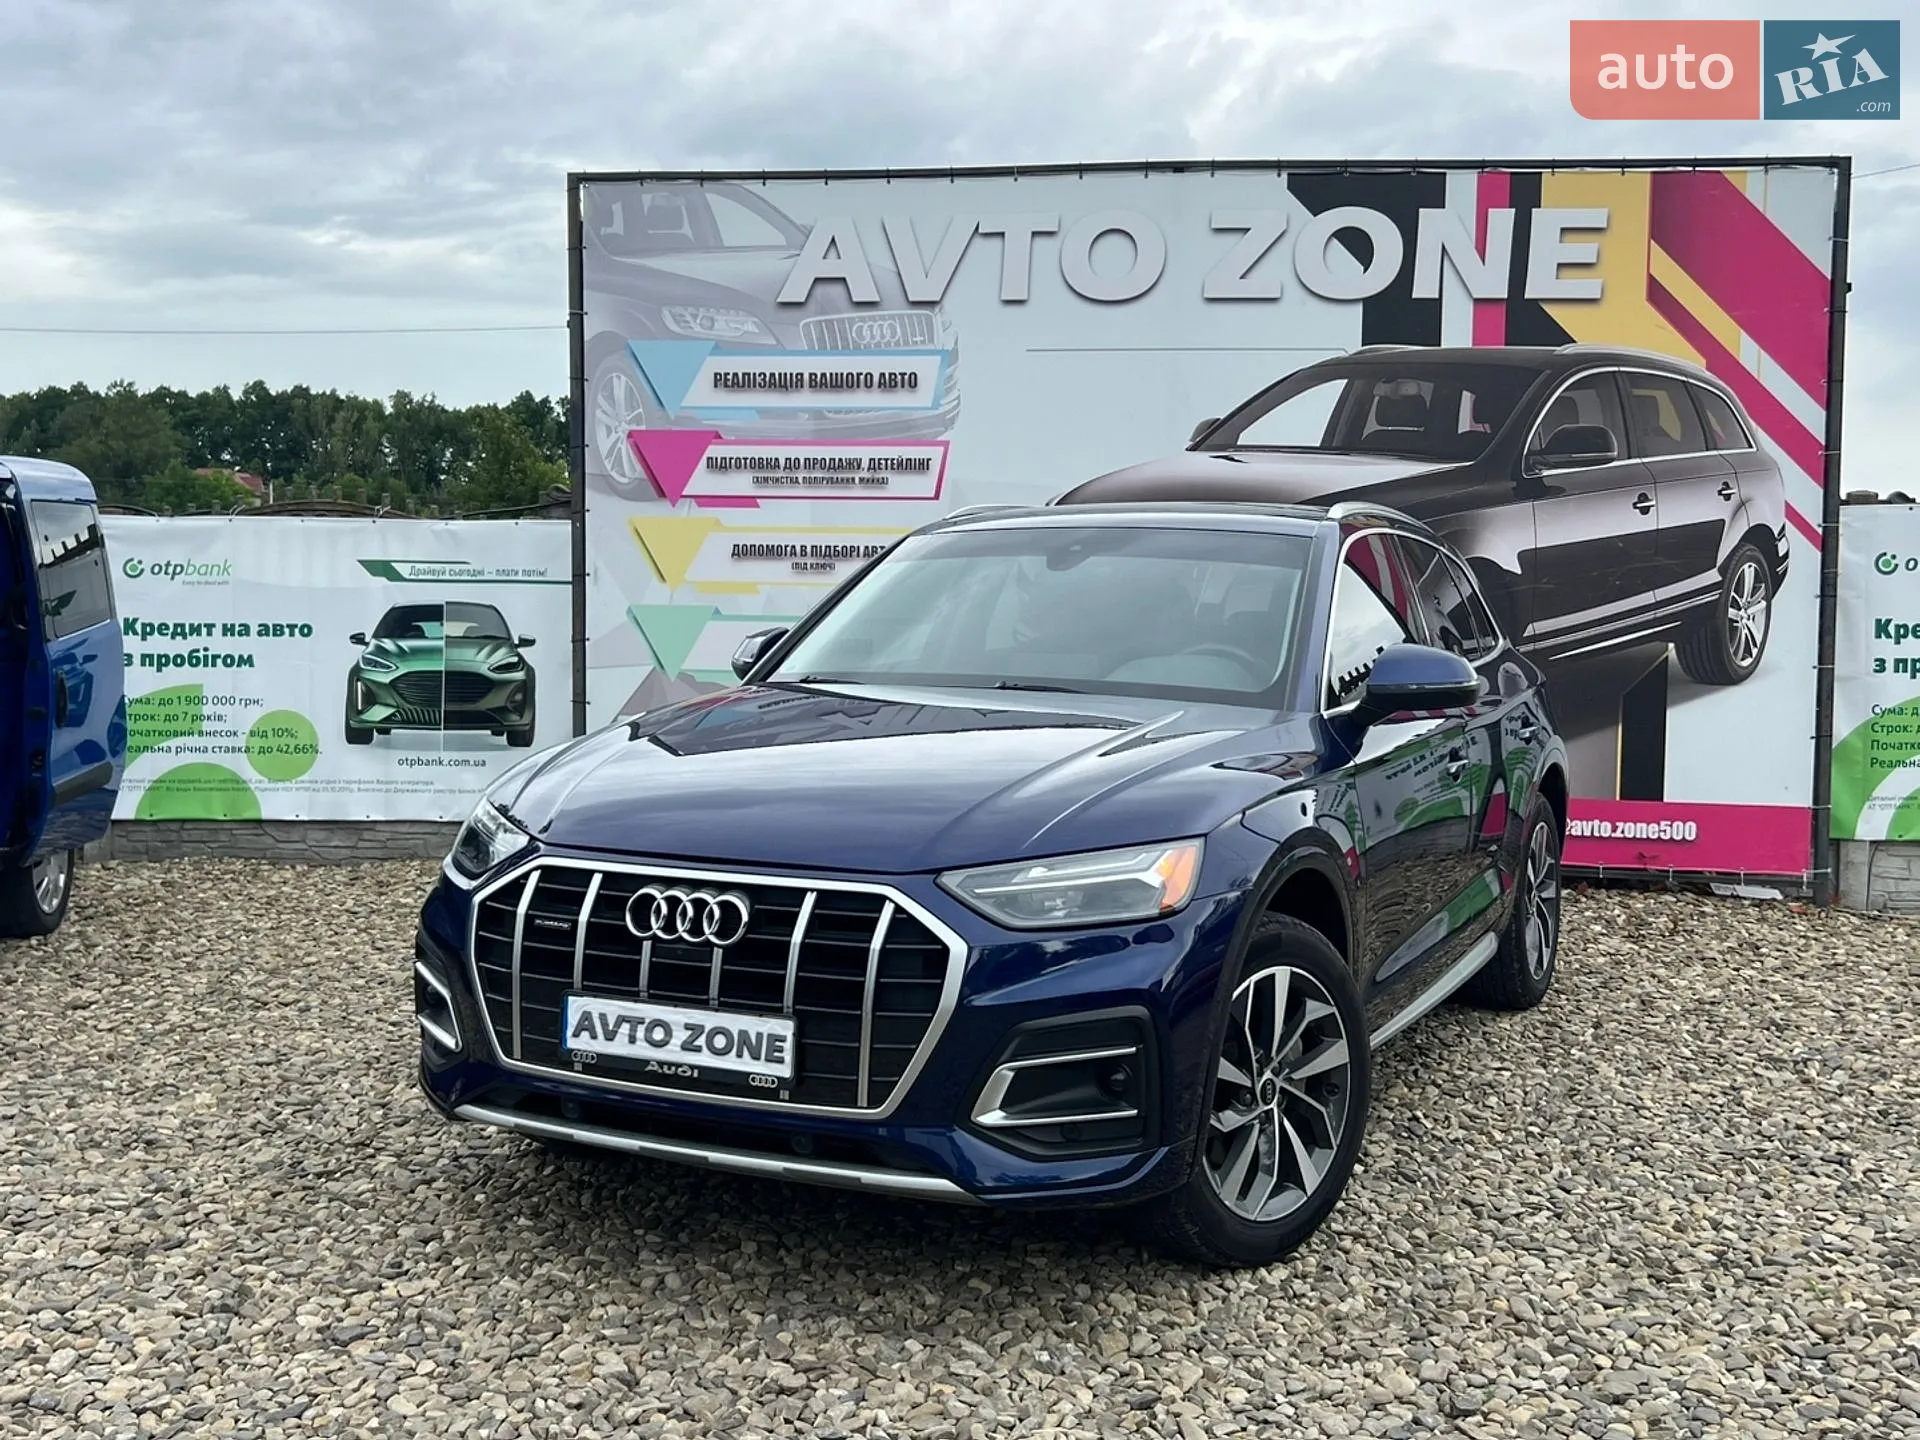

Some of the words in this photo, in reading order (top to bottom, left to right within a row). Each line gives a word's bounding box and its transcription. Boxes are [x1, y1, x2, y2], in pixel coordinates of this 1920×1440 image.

[776, 208, 1167, 304] AVTO
[1201, 206, 1609, 300] ZONE
[713, 372, 804, 391] РЕАЛІЗАЦІЯ
[808, 372, 874, 389] ВАШОГО
[877, 372, 918, 389] АВТО
[706, 456, 780, 471] ПІДГОТОВКА
[783, 457, 800, 472] ДО
[867, 455, 932, 471] ДЕТЕЙЛІНГ
[731, 544, 797, 558] ДОПОМОГА
[800, 544, 807, 558] В
[811, 544, 860, 559] ПІДБОРІ
[150, 558, 232, 581] otpbank
[409, 565, 446, 578] Драйвуй
[448, 566, 485, 578] сьогодні
[495, 568, 519, 577] плати
[521, 567, 548, 577] потім!
[123, 617, 216, 641] Кредит
[221, 623, 250, 637] на
[257, 623, 314, 637] авто
[140, 647, 255, 673] пробігом
[1873, 657, 1886, 674] з
[158, 697, 174, 707] до
[185, 696, 208, 705] 900
[212, 696, 236, 706] 000
[239, 697, 263, 708] грн;
[127, 713, 160, 723] трок:
[164, 713, 180, 723] до
[182, 711, 189, 721] 7
[191, 711, 228, 723] років;
[1871, 704, 1908, 718] Сума:
[128, 727, 194, 738] очатковий
[198, 728, 239, 738] внесок
[250, 727, 268, 739] від
[271, 727, 298, 739] 10%;
[1871, 722, 1912, 736] Строк:
[127, 744, 172, 754] еальна
[175, 743, 208, 756] річна
[211, 745, 253, 754] ставка:
[258, 744, 274, 755] до
[397, 756, 487, 768] otpbank.com.ua
[571, 1010, 674, 1048] AVTO
[680, 1022, 788, 1065] ZONE
[645, 1060, 699, 1078] Audi
